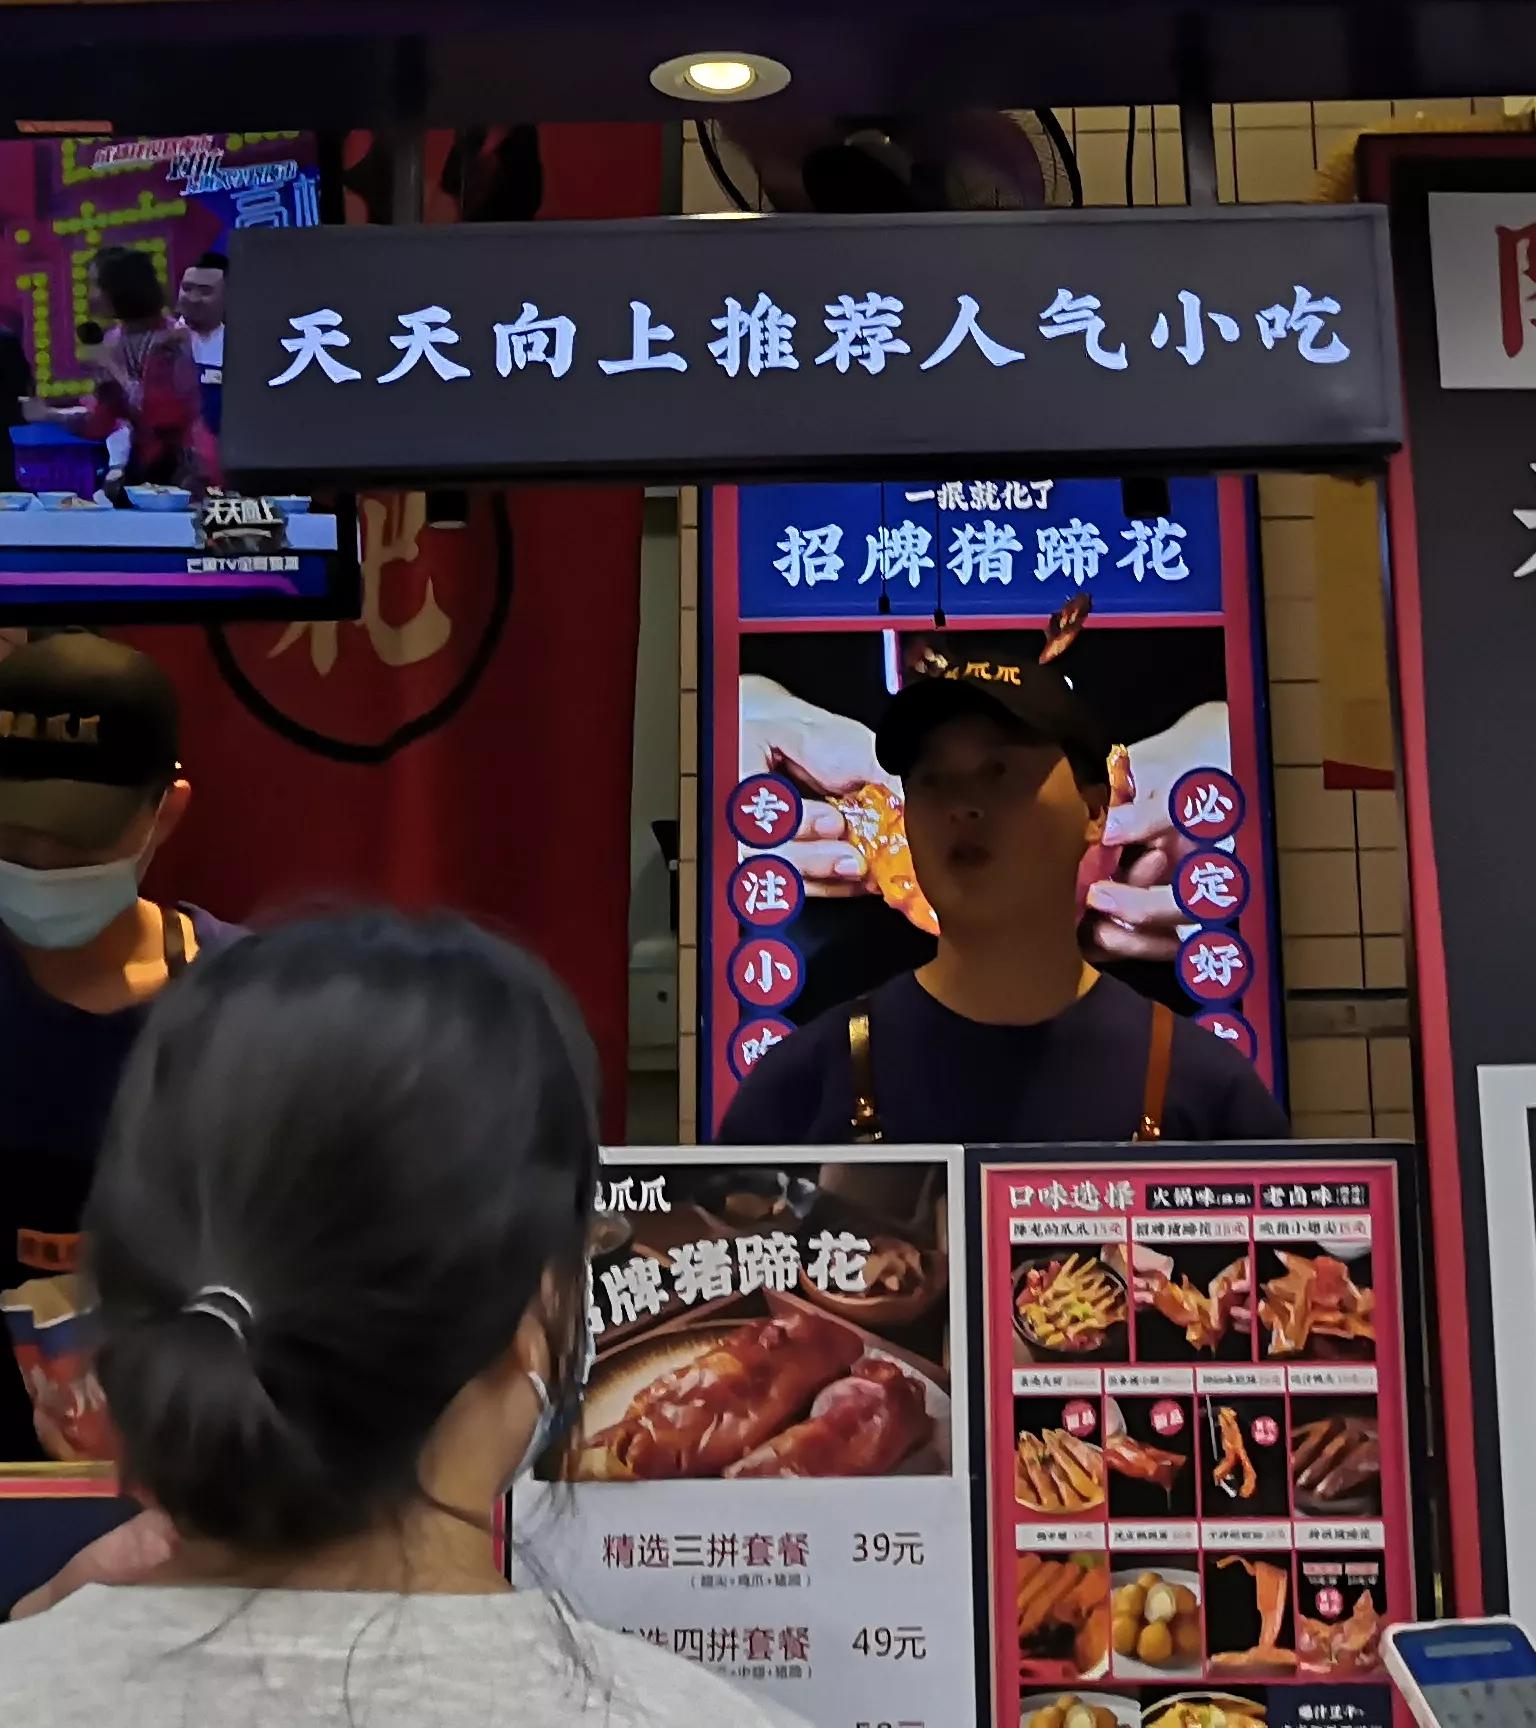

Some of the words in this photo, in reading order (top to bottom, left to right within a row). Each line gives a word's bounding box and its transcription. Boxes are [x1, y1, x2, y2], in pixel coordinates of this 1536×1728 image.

[269, 285, 1351, 387] 天天向上推荐人气小吃
[772, 516, 1190, 588] 招牌猪蹄花
[602, 1531, 811, 1569] 精选三拼套餐
[851, 1531, 926, 1567] 39元
[852, 1626, 928, 1661] 49元
